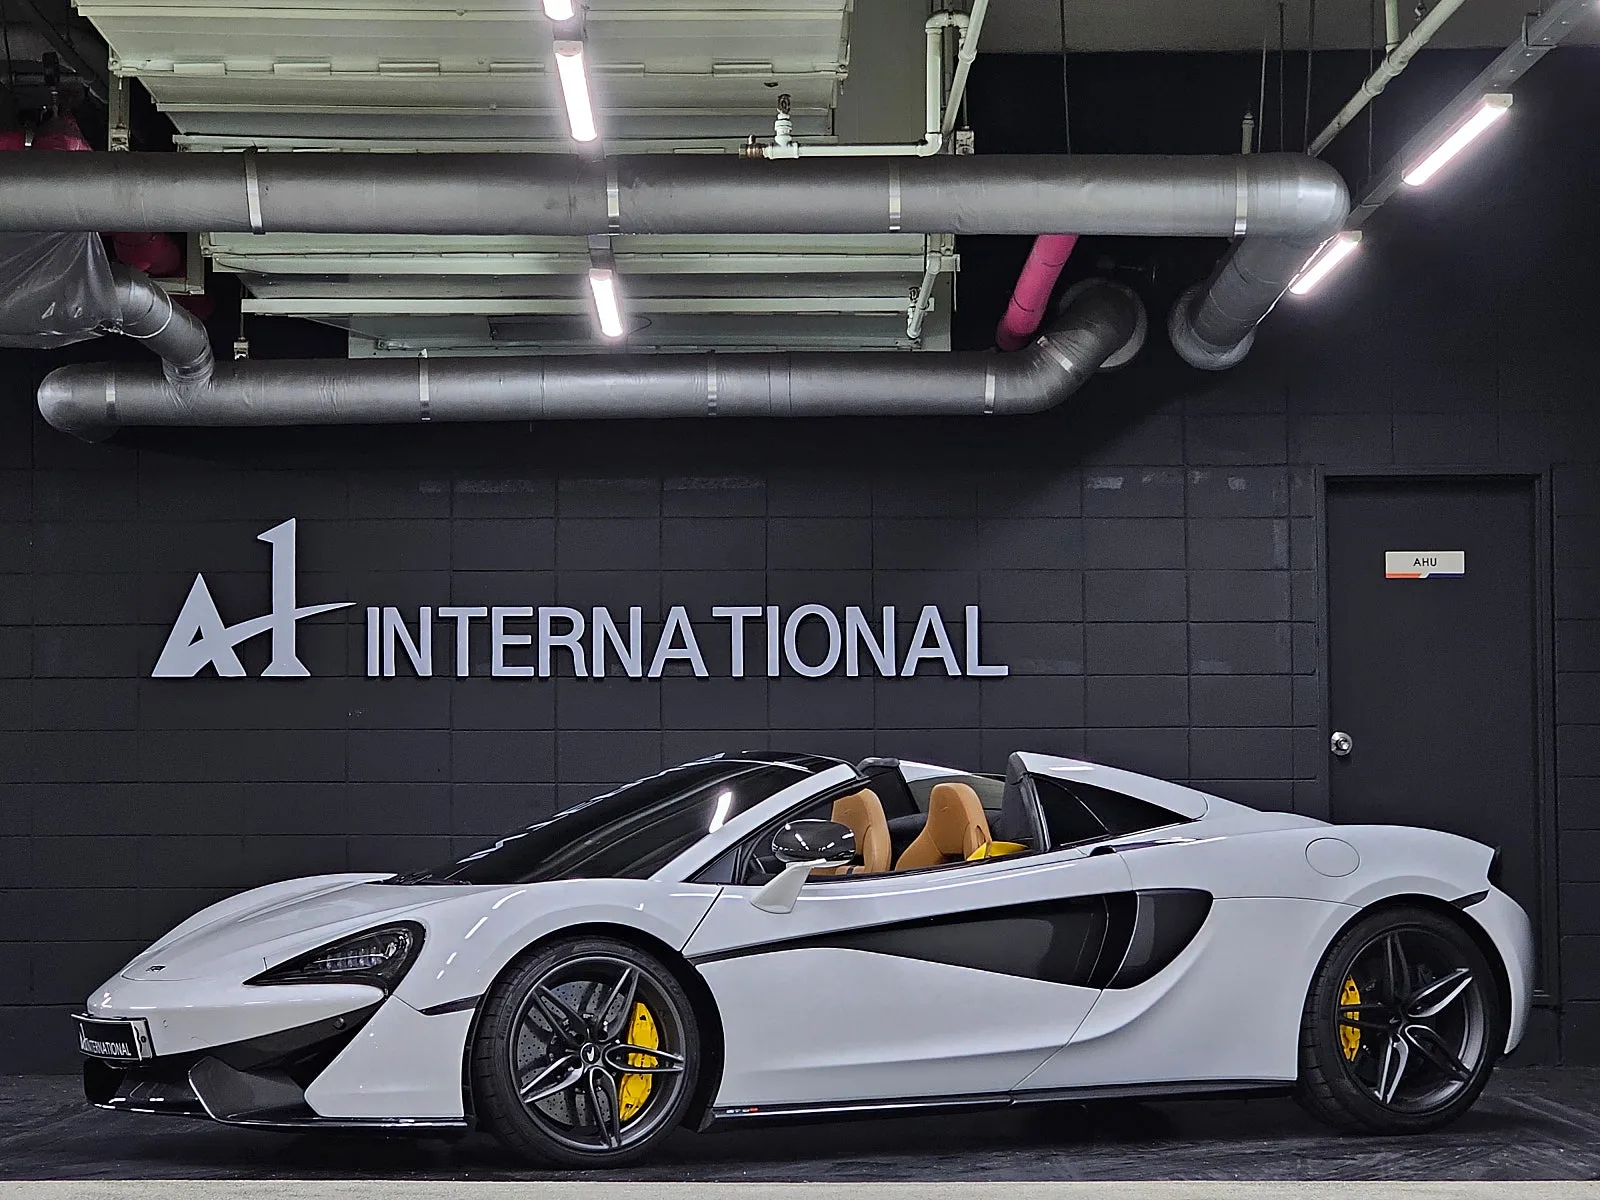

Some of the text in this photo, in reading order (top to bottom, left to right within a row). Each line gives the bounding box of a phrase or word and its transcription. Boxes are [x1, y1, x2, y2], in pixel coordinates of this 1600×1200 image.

[151, 517, 1009, 679] A1 INTERNATIONAL
[1412, 557, 1438, 567] AHU
